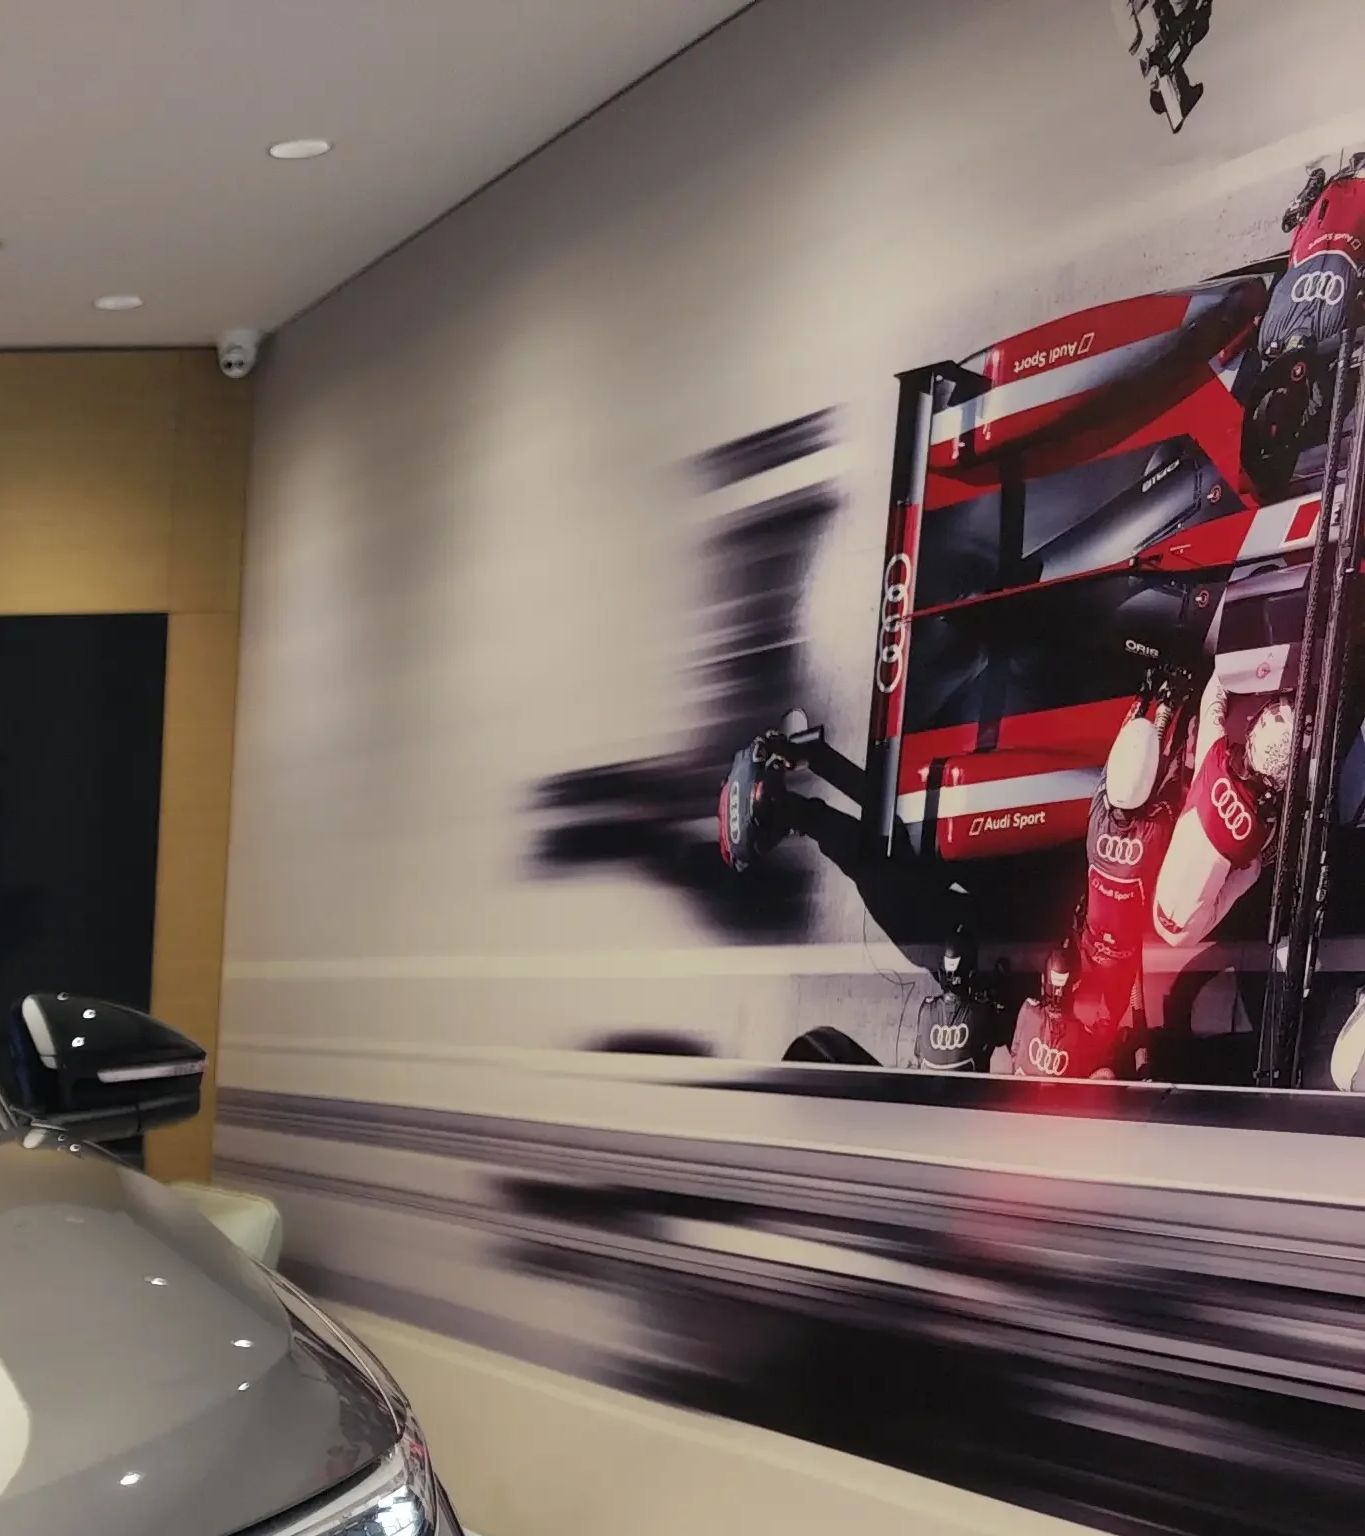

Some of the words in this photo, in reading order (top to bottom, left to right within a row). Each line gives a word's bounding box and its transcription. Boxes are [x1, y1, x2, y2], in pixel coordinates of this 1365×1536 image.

[1013, 350, 1047, 373] Sport
[1049, 341, 1078, 364] Audi
[984, 814, 1011, 831] Audi
[1013, 811, 1045, 829] Sport
